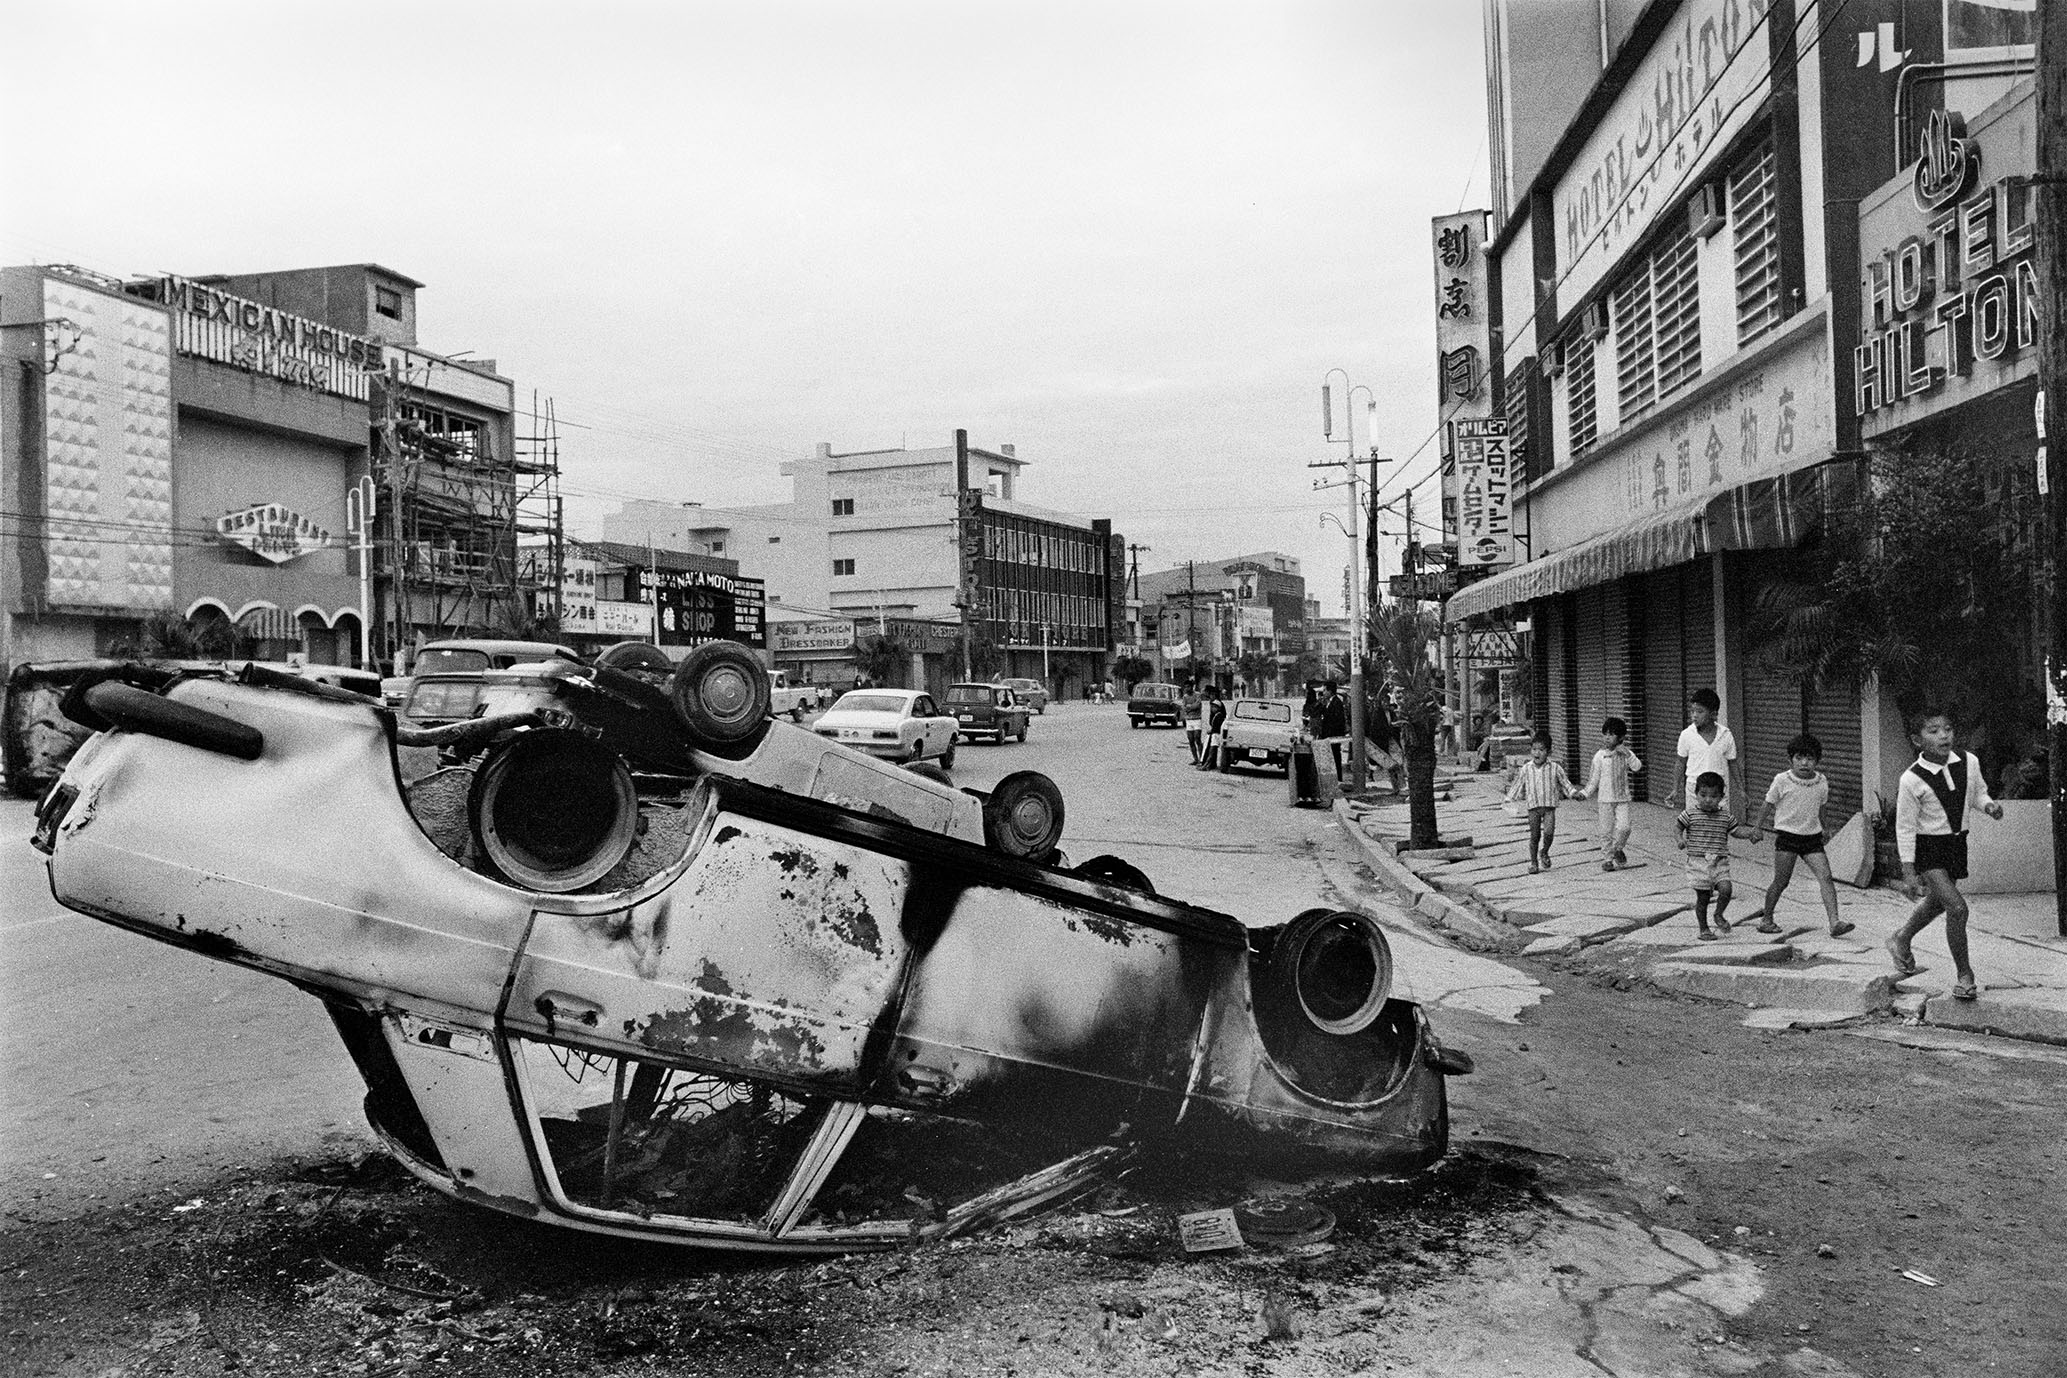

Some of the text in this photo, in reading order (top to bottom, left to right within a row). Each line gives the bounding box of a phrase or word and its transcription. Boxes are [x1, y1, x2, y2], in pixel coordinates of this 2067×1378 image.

[1856, 22, 1913, 73] ル
[1674, 97, 1723, 170] ホテル
[1565, 133, 1633, 272] HOTEL
[1867, 176, 2034, 330] HOTEL
[169, 277, 386, 372] MEXICAN HOUSE
[1739, 373, 1764, 402] STORE
[1486, 440, 1509, 534] スロットマシン
[223, 506, 330, 543] RESTAURANT
[1468, 545, 1507, 555] PEPSI
[681, 610, 715, 632] SHOP
[774, 624, 799, 637] NEW
[803, 623, 852, 635] FASHION
[778, 637, 850, 649] DRESSMAKER
